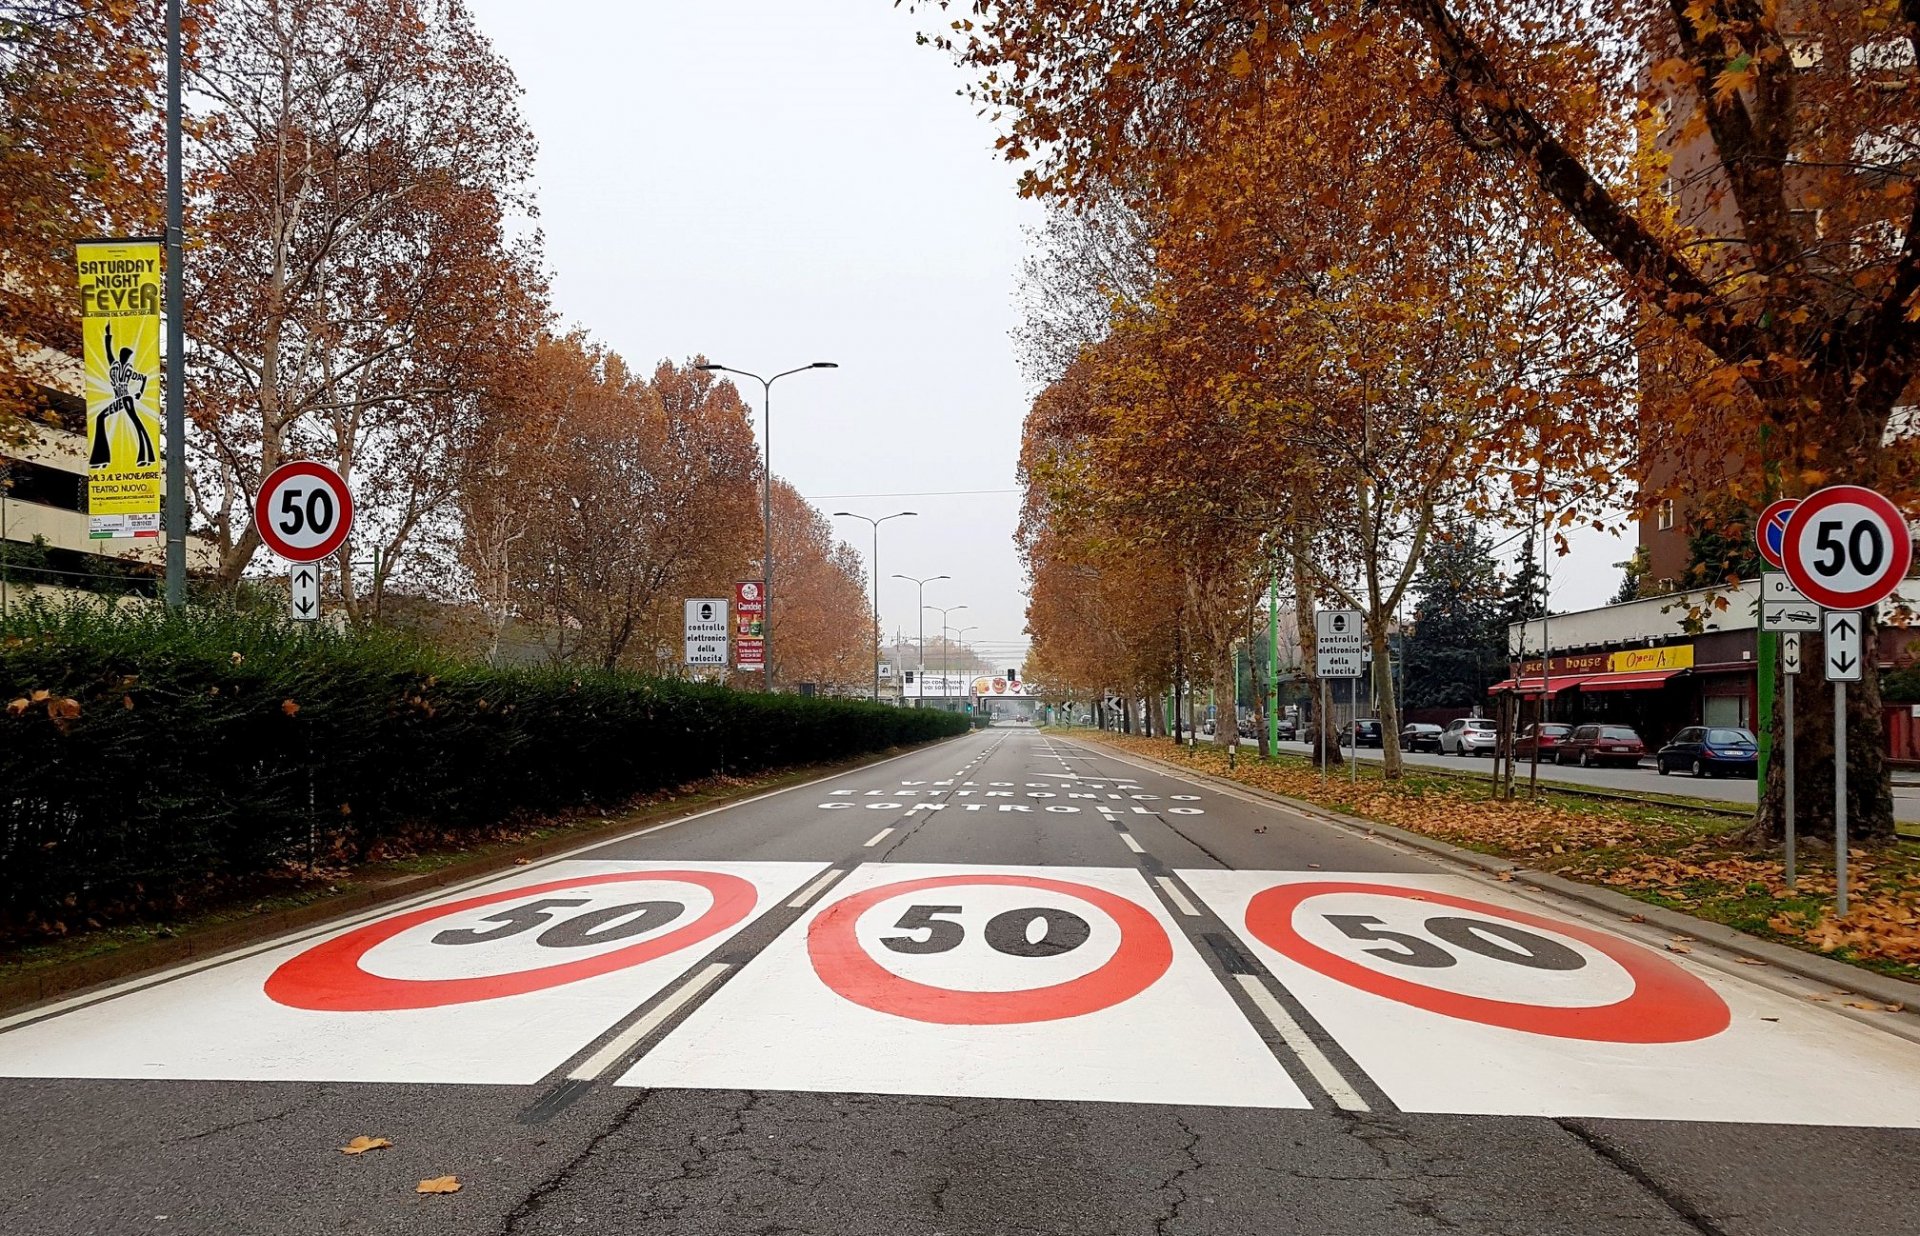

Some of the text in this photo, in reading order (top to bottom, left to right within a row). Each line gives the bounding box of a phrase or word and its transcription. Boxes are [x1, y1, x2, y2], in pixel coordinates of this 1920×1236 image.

[80, 259, 155, 275] SATURDAY
[95, 274, 140, 289] NIGHT
[81, 282, 158, 317] FEVER
[100, 474, 105, 482] 3
[91, 484, 147, 494] TEATRO NUOVO
[279, 487, 333, 536] 50
[1813, 519, 1884, 577] 50
[688, 623, 725, 631] controllo
[687, 634, 727, 642] elettronico
[1320, 635, 1359, 643] controllo
[1319, 646, 1360, 654] elettronico
[1330, 657, 1349, 665] della
[1565, 657, 1602, 669] house
[1626, 652, 1654, 668] Open
[828, 789, 1202, 801] ELETTRONICO
[817, 802, 1206, 815] CONTROLLO
[431, 898, 685, 949] 50
[879, 905, 1091, 958] 50
[1321, 914, 1587, 970] 50
